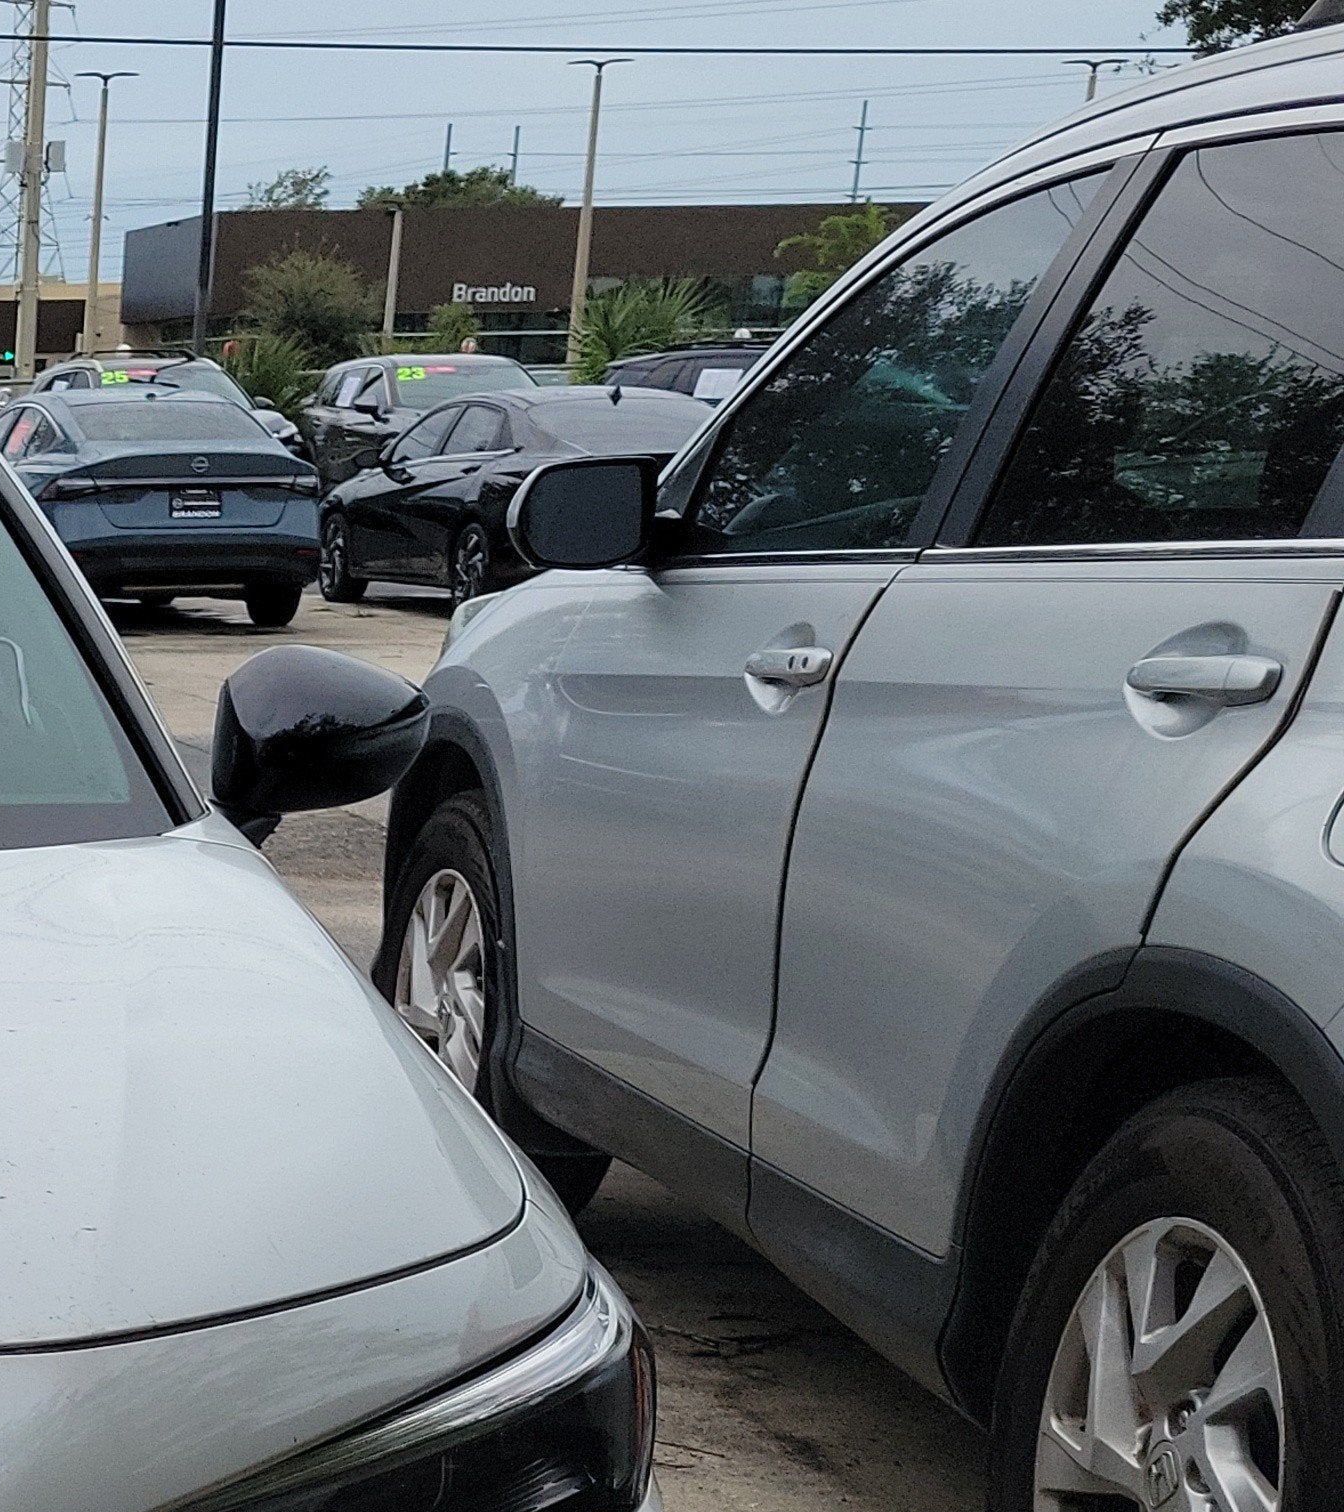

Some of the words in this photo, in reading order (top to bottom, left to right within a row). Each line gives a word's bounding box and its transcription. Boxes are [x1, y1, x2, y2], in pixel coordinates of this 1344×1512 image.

[452, 282, 536, 302] Brandon
[101, 369, 129, 384] 25
[397, 366, 426, 381] 23
